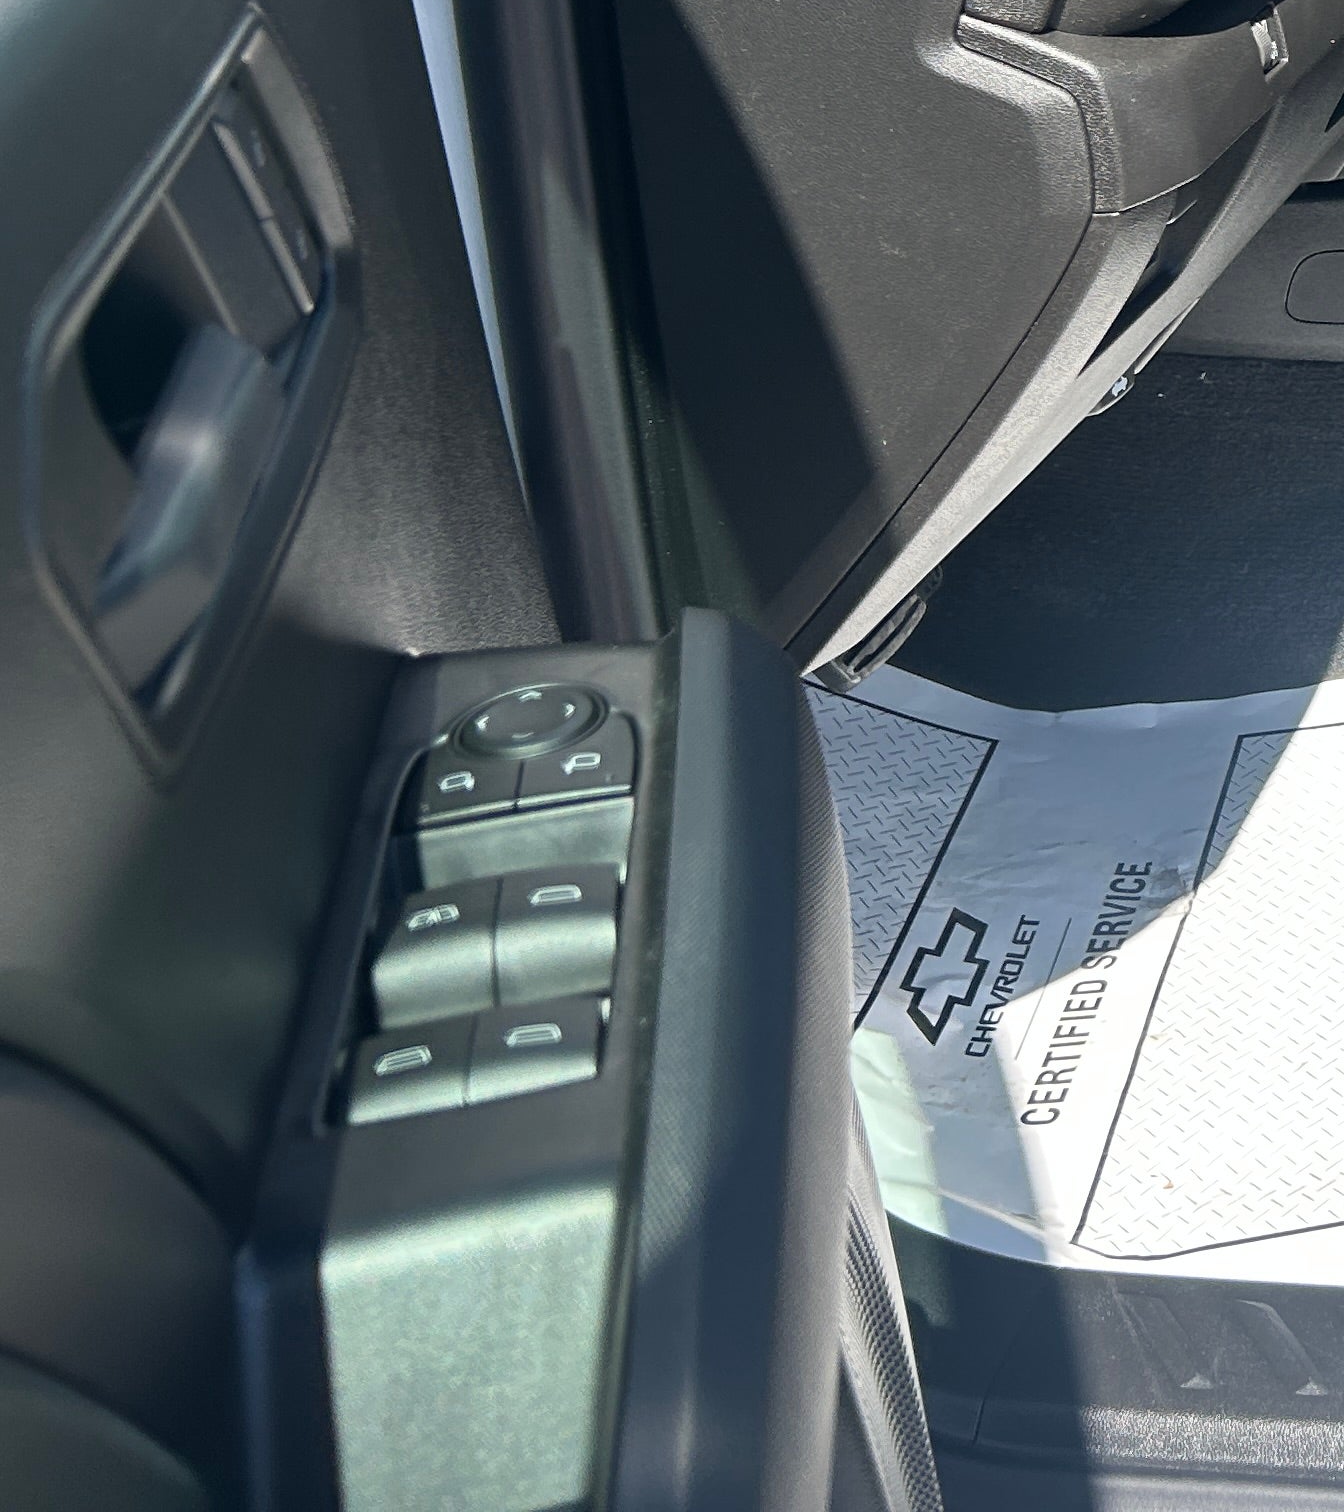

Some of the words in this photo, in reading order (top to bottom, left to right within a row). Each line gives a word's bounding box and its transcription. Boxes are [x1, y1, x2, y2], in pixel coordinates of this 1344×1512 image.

[965, 914, 1043, 1059] CHEVROLET
[1020, 979, 1109, 1127] CERTIFIED
[1082, 859, 1154, 972] SERVICE
